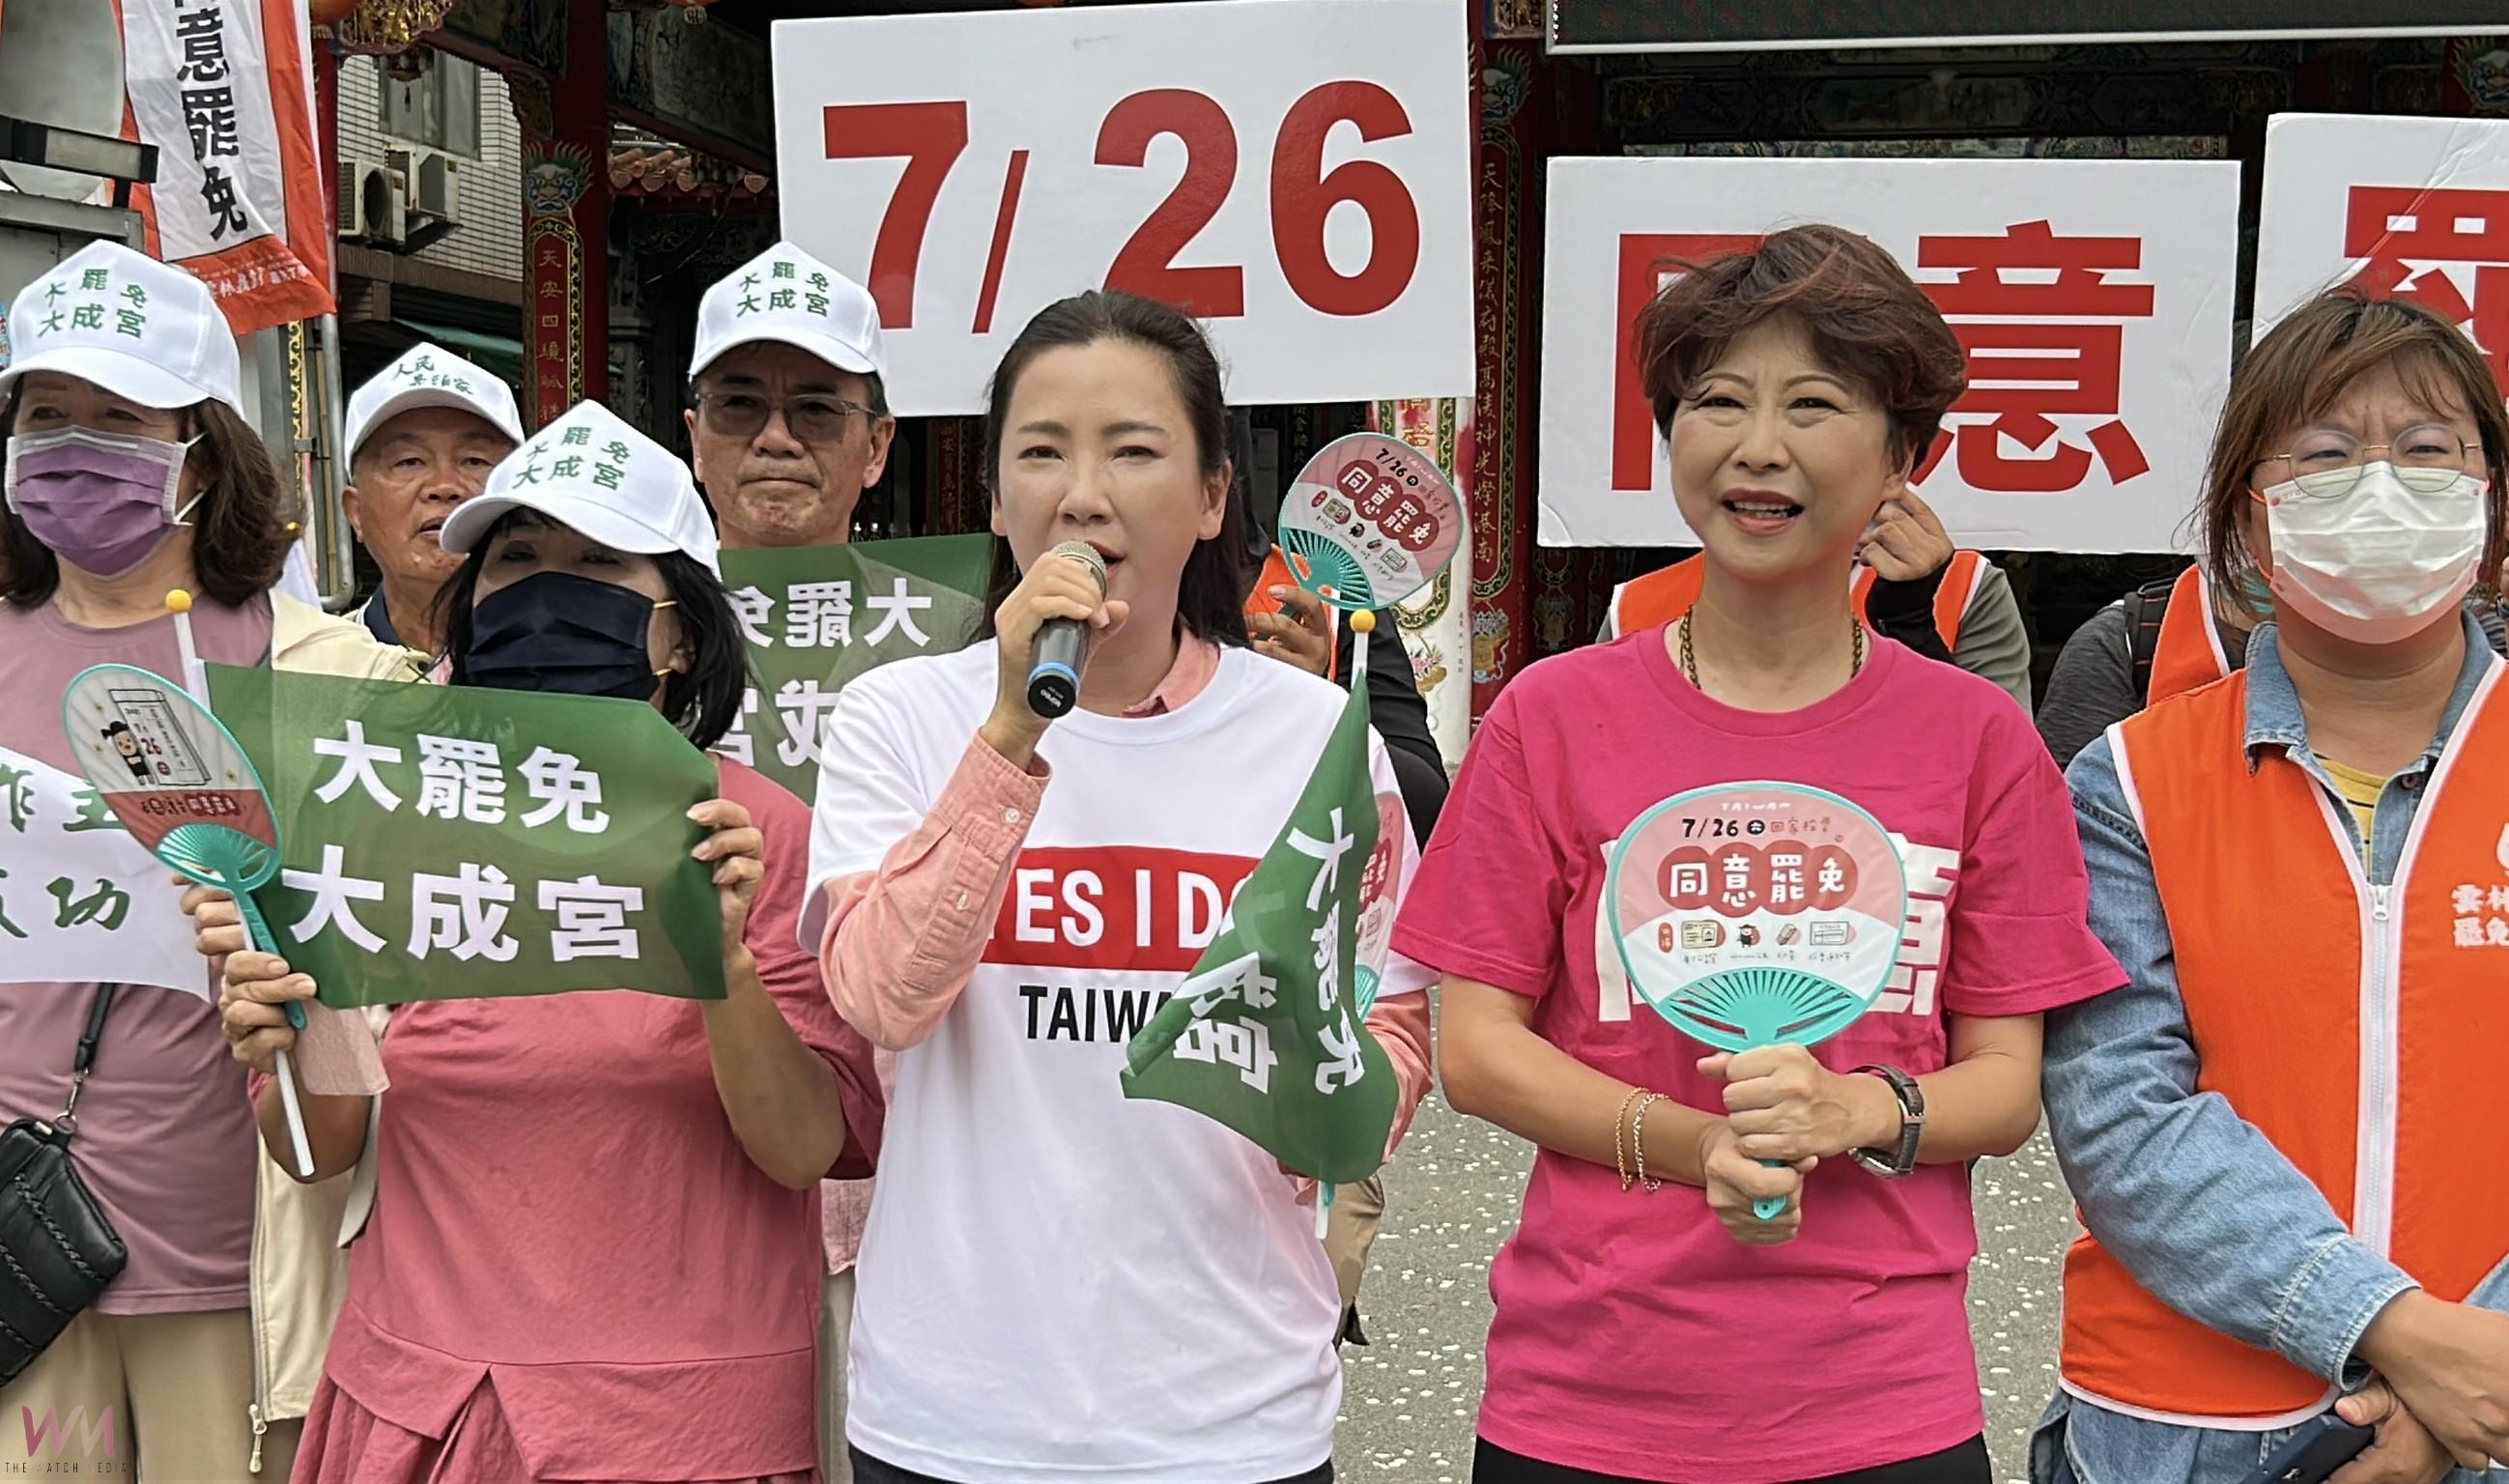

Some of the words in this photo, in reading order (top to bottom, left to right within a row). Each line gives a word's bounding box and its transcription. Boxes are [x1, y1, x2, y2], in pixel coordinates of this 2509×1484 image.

[175, 0, 248, 241] 意罷免
[824, 79, 1420, 334] 7/26
[44, 269, 148, 308] 大罷免
[736, 288, 830, 317] 大成宮
[739, 262, 829, 293] 大罷免
[38, 302, 147, 339] 大成宮
[391, 355, 435, 381] 人民
[527, 426, 631, 464] 大罷免
[512, 455, 625, 491] 大成宮
[1341, 467, 1431, 544] 同意罷免
[314, 720, 611, 834] 大罷免
[1682, 818, 1739, 838] 7/26
[0, 870, 130, 931] 功
[282, 844, 644, 962] 大成宮
[1670, 853, 1845, 907] 同意罷免
[986, 868, 1105, 948] ES
[1135, 869, 1152, 947] I
[1019, 985, 1172, 1042] TAIW
